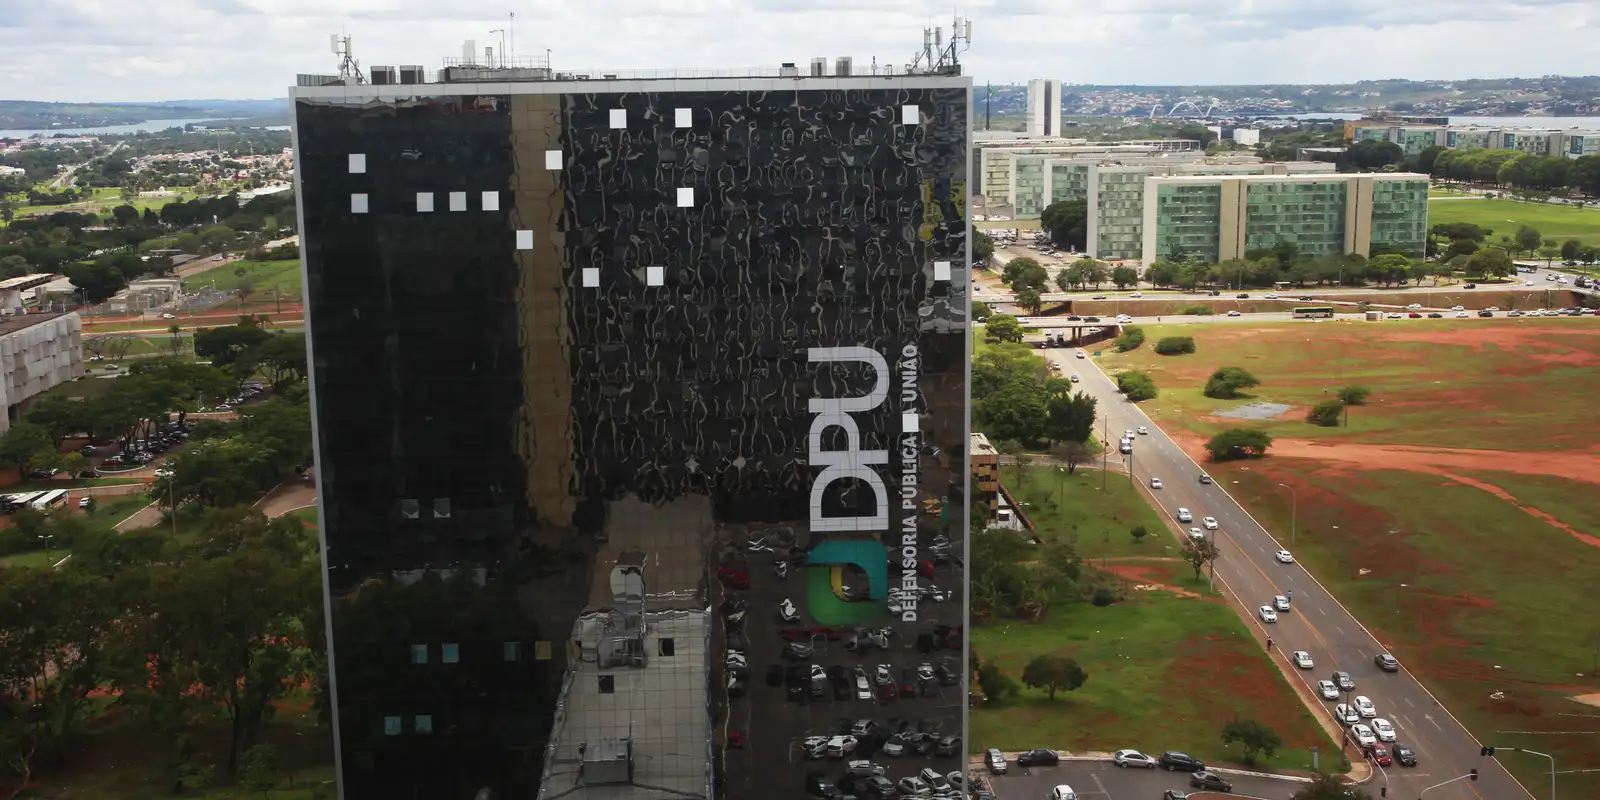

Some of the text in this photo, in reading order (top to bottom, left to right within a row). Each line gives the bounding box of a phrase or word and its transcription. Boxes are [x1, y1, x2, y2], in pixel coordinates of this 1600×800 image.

[899, 344, 918, 402] UNIÃO
[808, 346, 890, 532] DPU
[899, 435, 917, 510] PÚBLICA
[902, 515, 917, 622] DEFENSORIA
